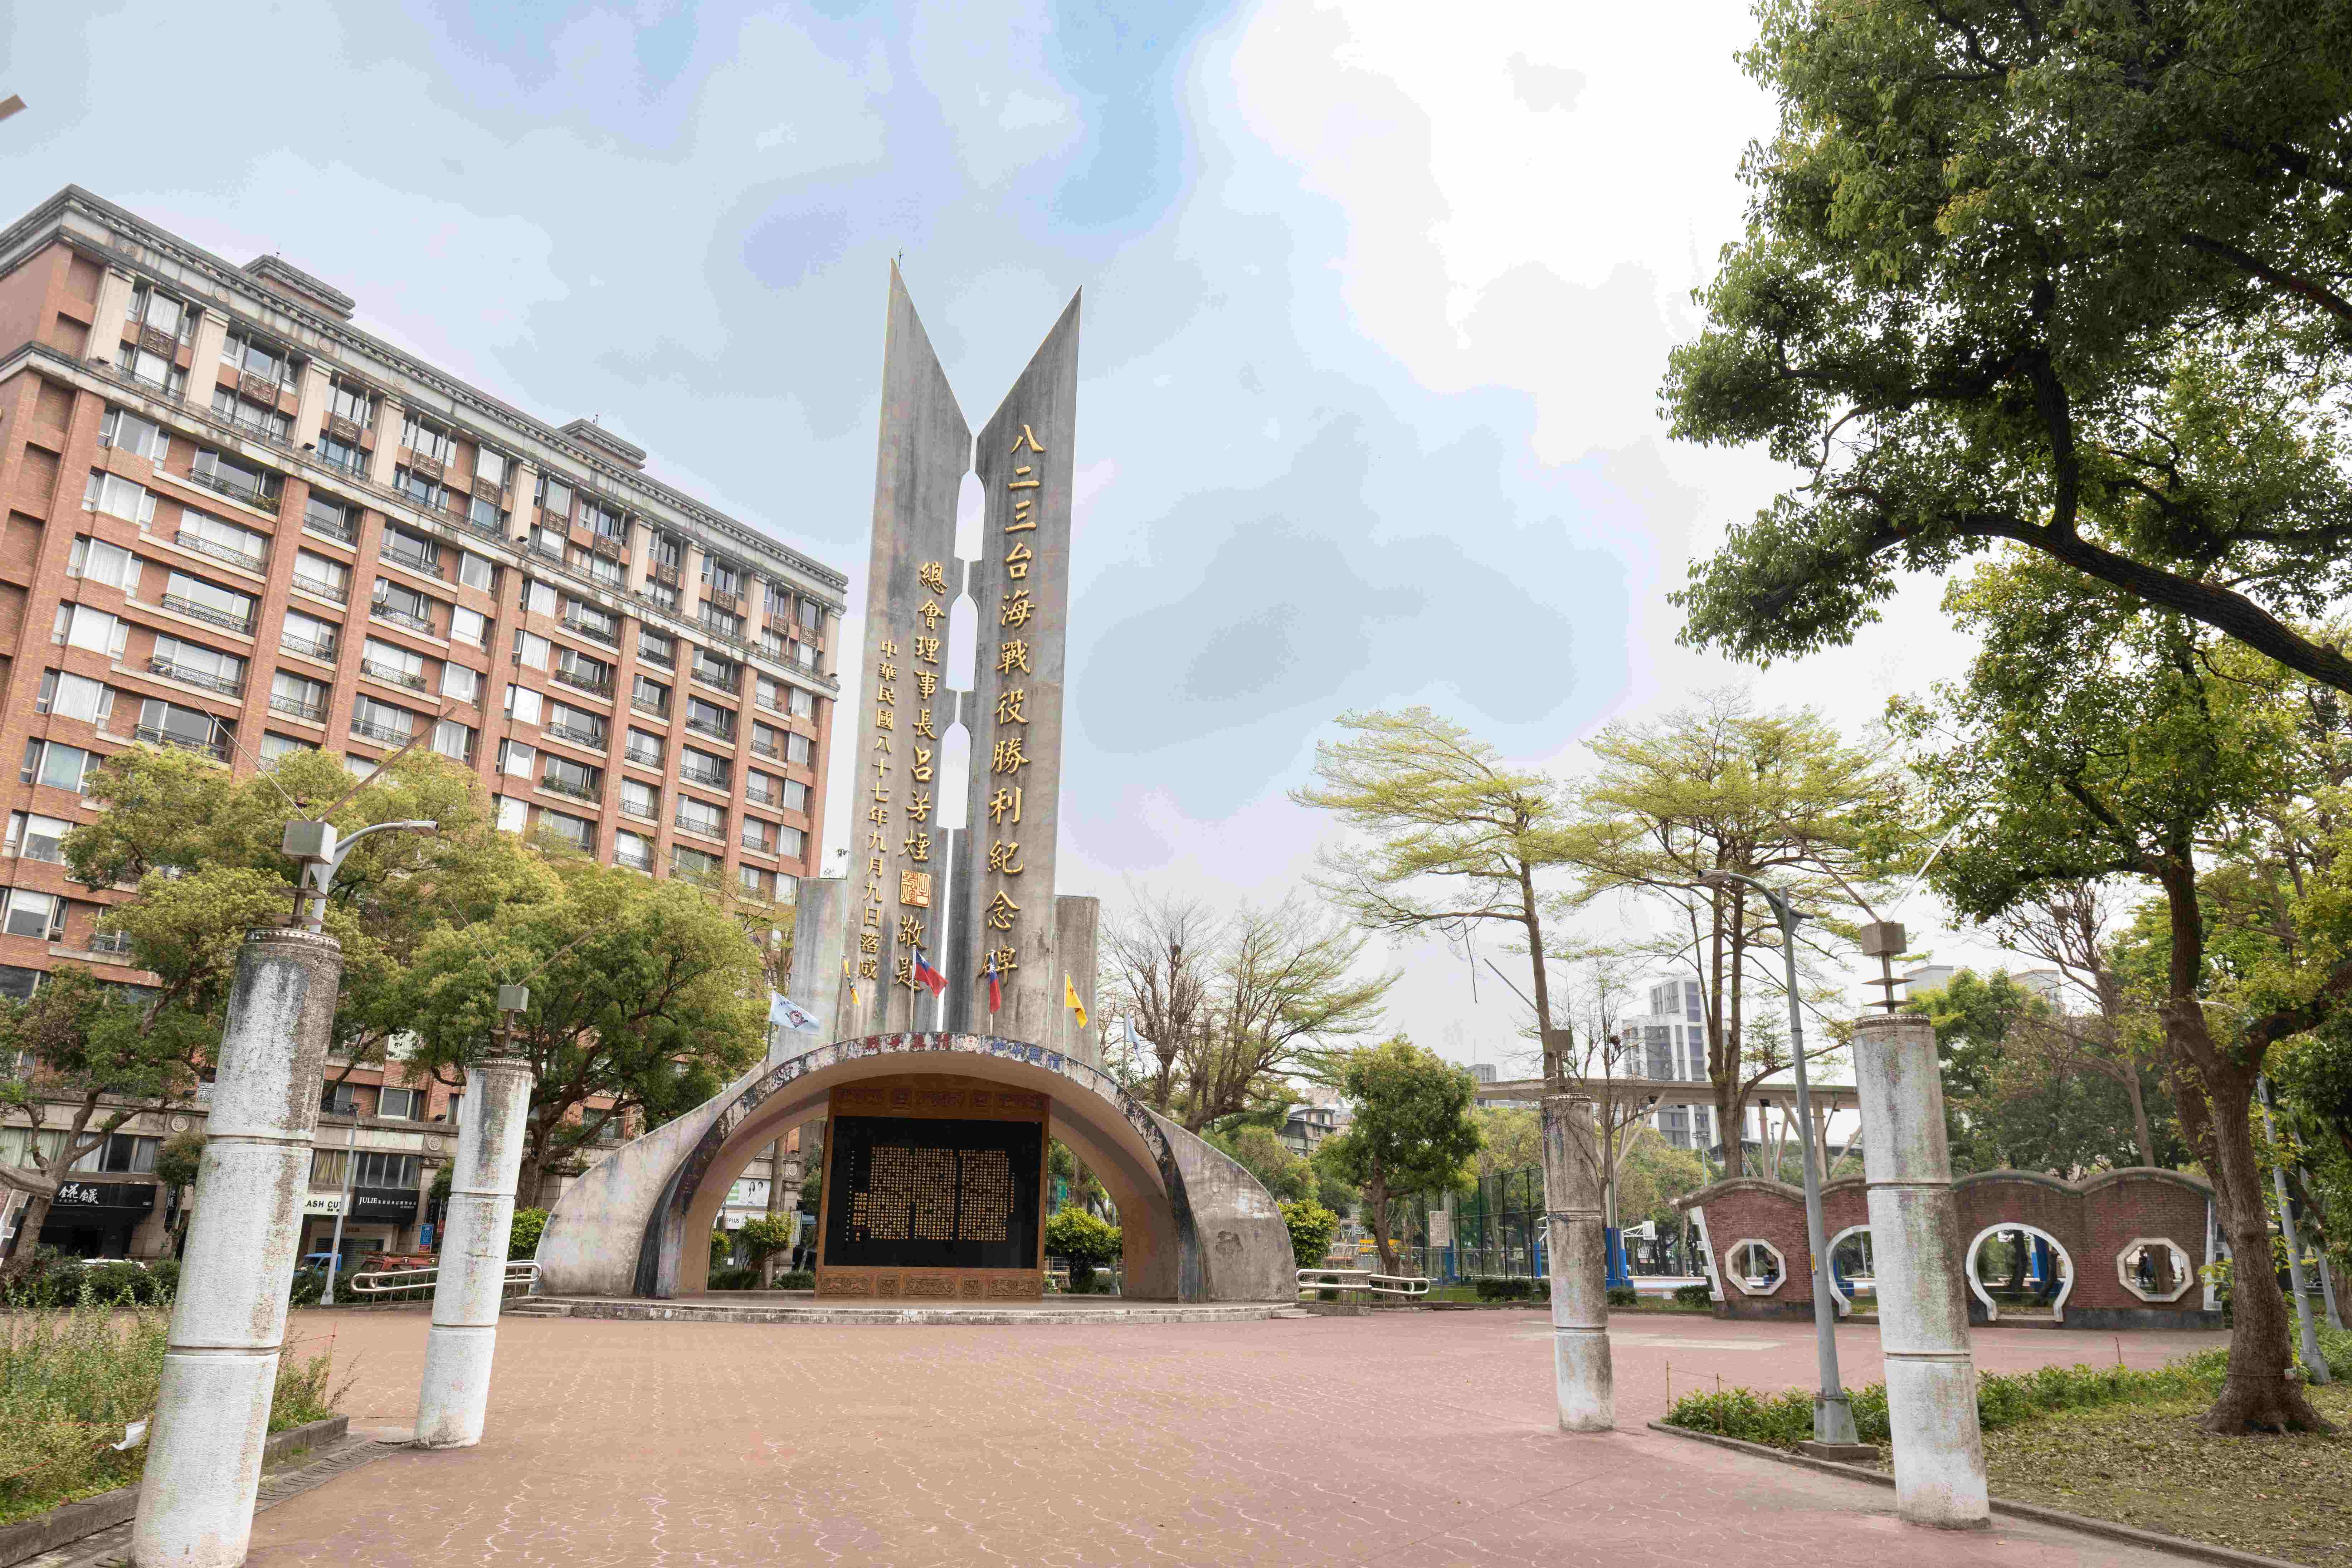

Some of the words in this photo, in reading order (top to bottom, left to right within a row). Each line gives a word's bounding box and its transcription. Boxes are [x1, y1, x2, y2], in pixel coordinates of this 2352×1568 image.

[858, 640, 898, 980] 中華民國八十七年九月九日落成
[899, 561, 948, 862] 總會理事長呂芳煙
[979, 424, 1045, 986] 八二三台海戰役勝利紀念碑
[359, 1197, 378, 1205] JULIE
